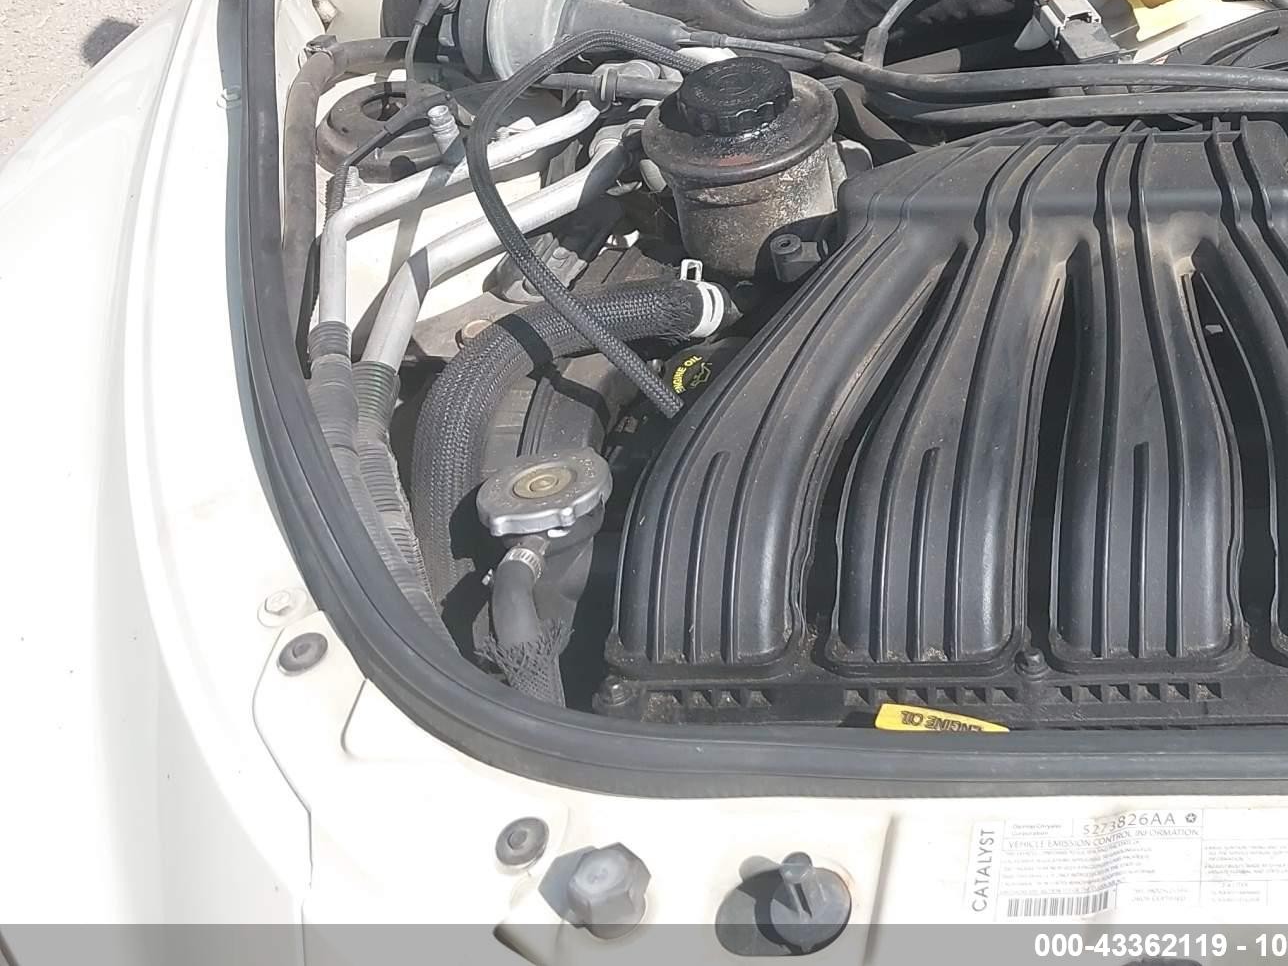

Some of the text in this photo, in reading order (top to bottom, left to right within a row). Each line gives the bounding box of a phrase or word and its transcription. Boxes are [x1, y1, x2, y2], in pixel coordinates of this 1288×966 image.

[672, 355, 703, 394] ENGINE OIL
[900, 710, 923, 726] OIL
[1083, 812, 1176, 835] 5273826AA
[1047, 838, 1091, 848] EMISSION
[1092, 830, 1132, 846] CONTROL
[1135, 828, 1200, 836] INFORMATION
[971, 829, 995, 912] CATALYST
